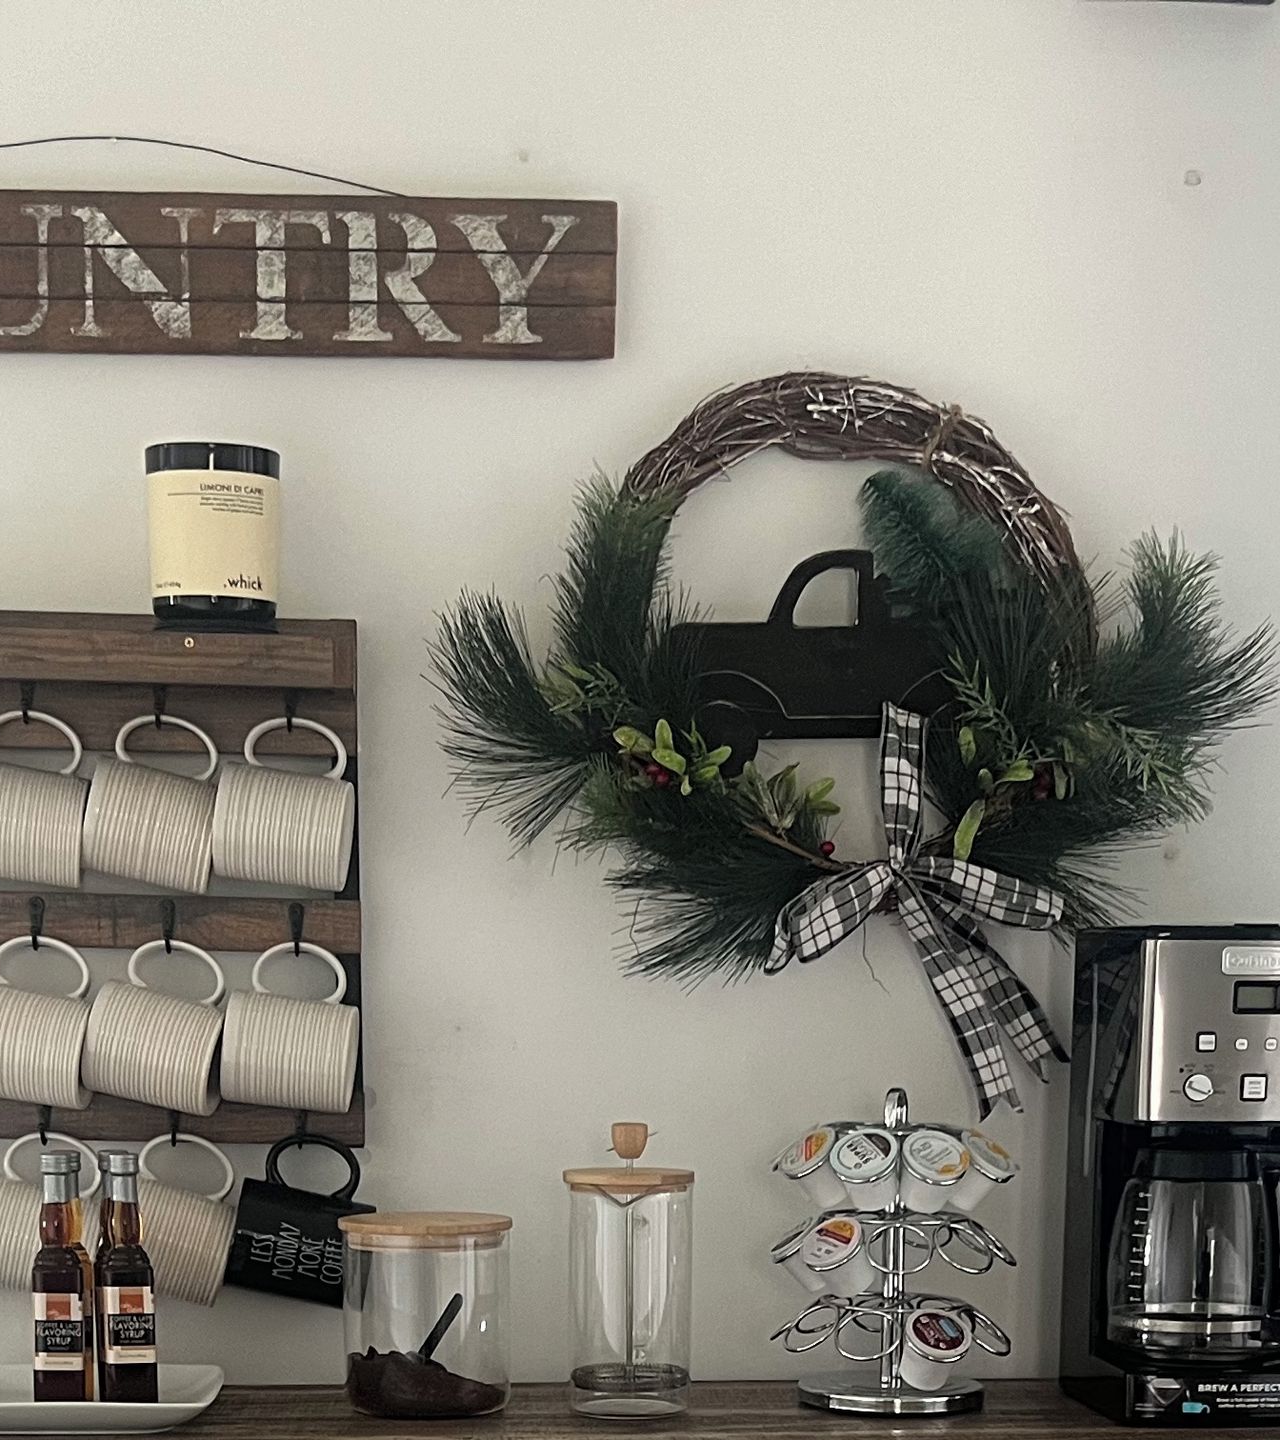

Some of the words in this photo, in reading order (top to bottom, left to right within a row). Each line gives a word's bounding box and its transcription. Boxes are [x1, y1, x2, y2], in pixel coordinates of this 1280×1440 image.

[200, 483, 232, 492] LIMONI
[234, 485, 242, 493] DI
[250, 1232, 275, 1263] LESS
[272, 1221, 300, 1280] MONDAY
[297, 1235, 325, 1278] MORE
[110, 1321, 154, 1331] FLAVORING
[36, 1327, 82, 1337] FLAVORING
[120, 1330, 146, 1339] SYRUP
[46, 1336, 72, 1346] SYRUP
[1198, 1383, 1229, 1392] BREW
[1230, 1383, 1238, 1392] A
